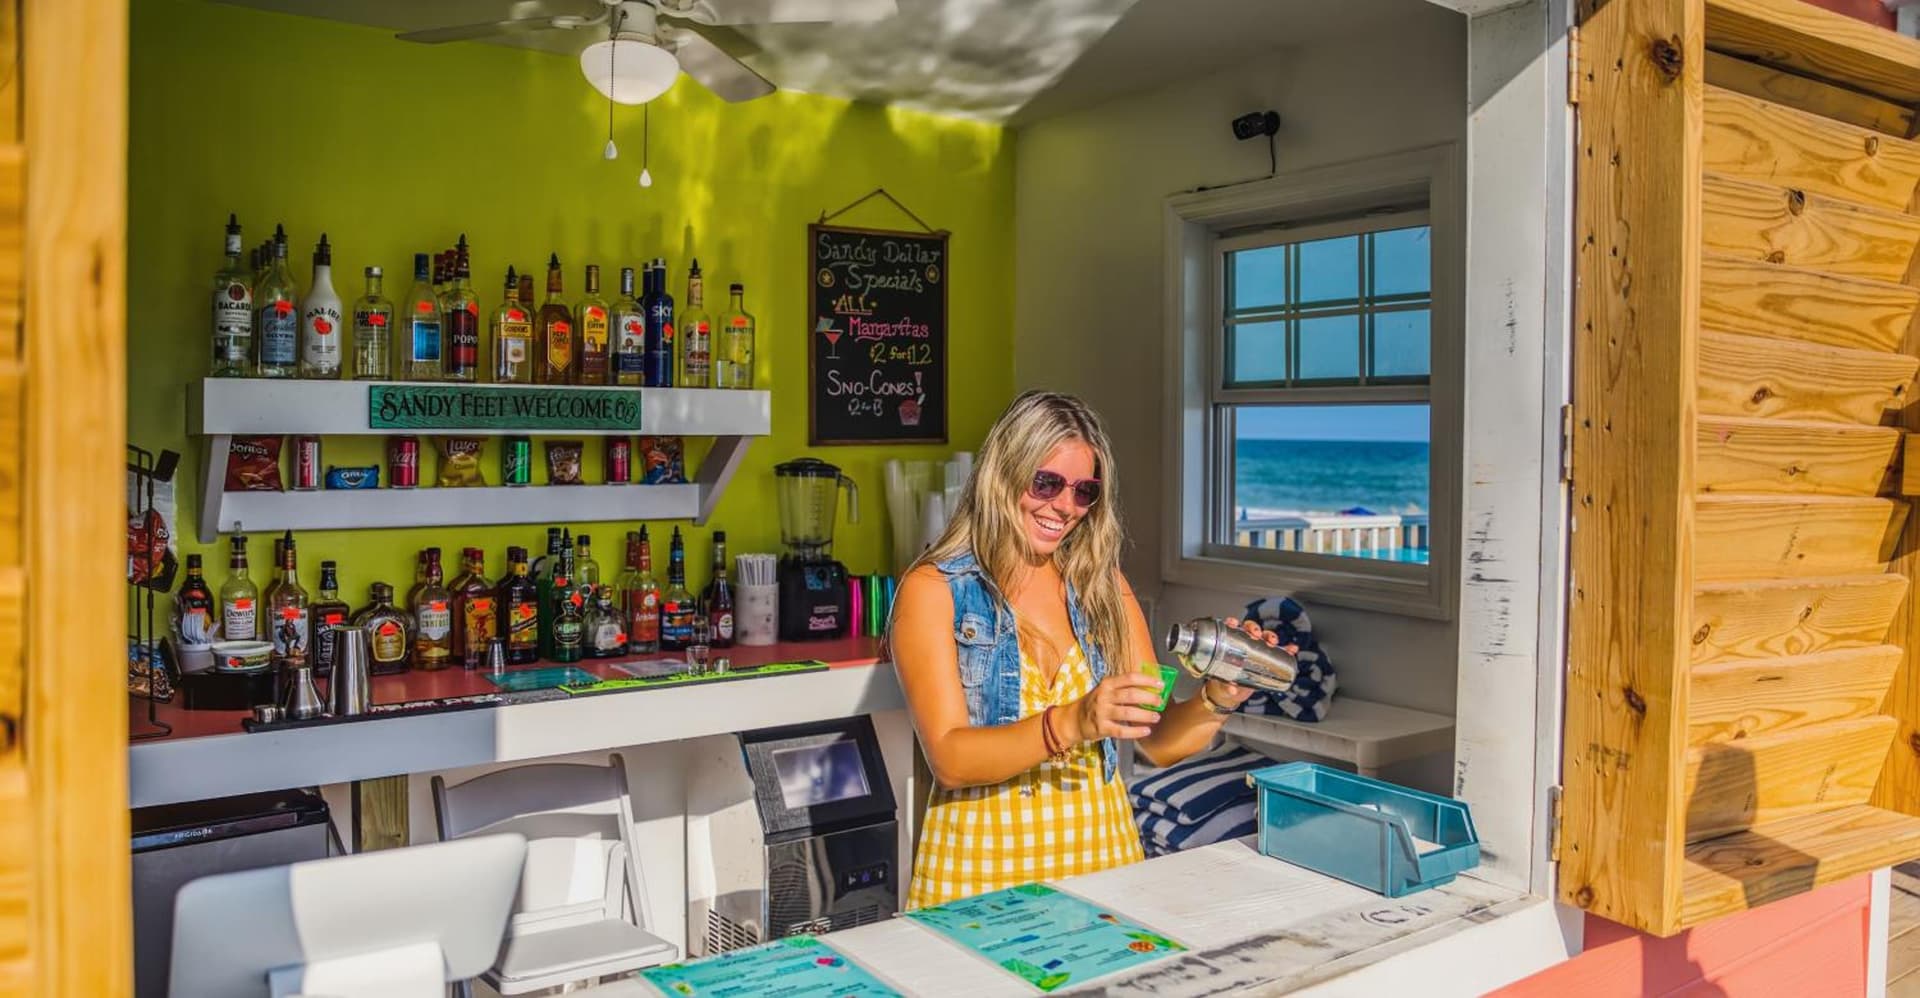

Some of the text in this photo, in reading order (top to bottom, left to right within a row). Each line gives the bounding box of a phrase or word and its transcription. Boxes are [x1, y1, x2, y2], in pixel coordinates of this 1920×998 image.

[818, 233, 940, 267] Sandy Dollar
[845, 263, 923, 297] Specials
[217, 302, 251, 311] BACARD
[651, 305, 672, 317] SKY
[834, 294, 873, 314] ALL
[453, 334, 478, 345] POPO
[849, 316, 929, 342] Margaritas
[379, 392, 615, 422] SANDY FEET WELCOME
